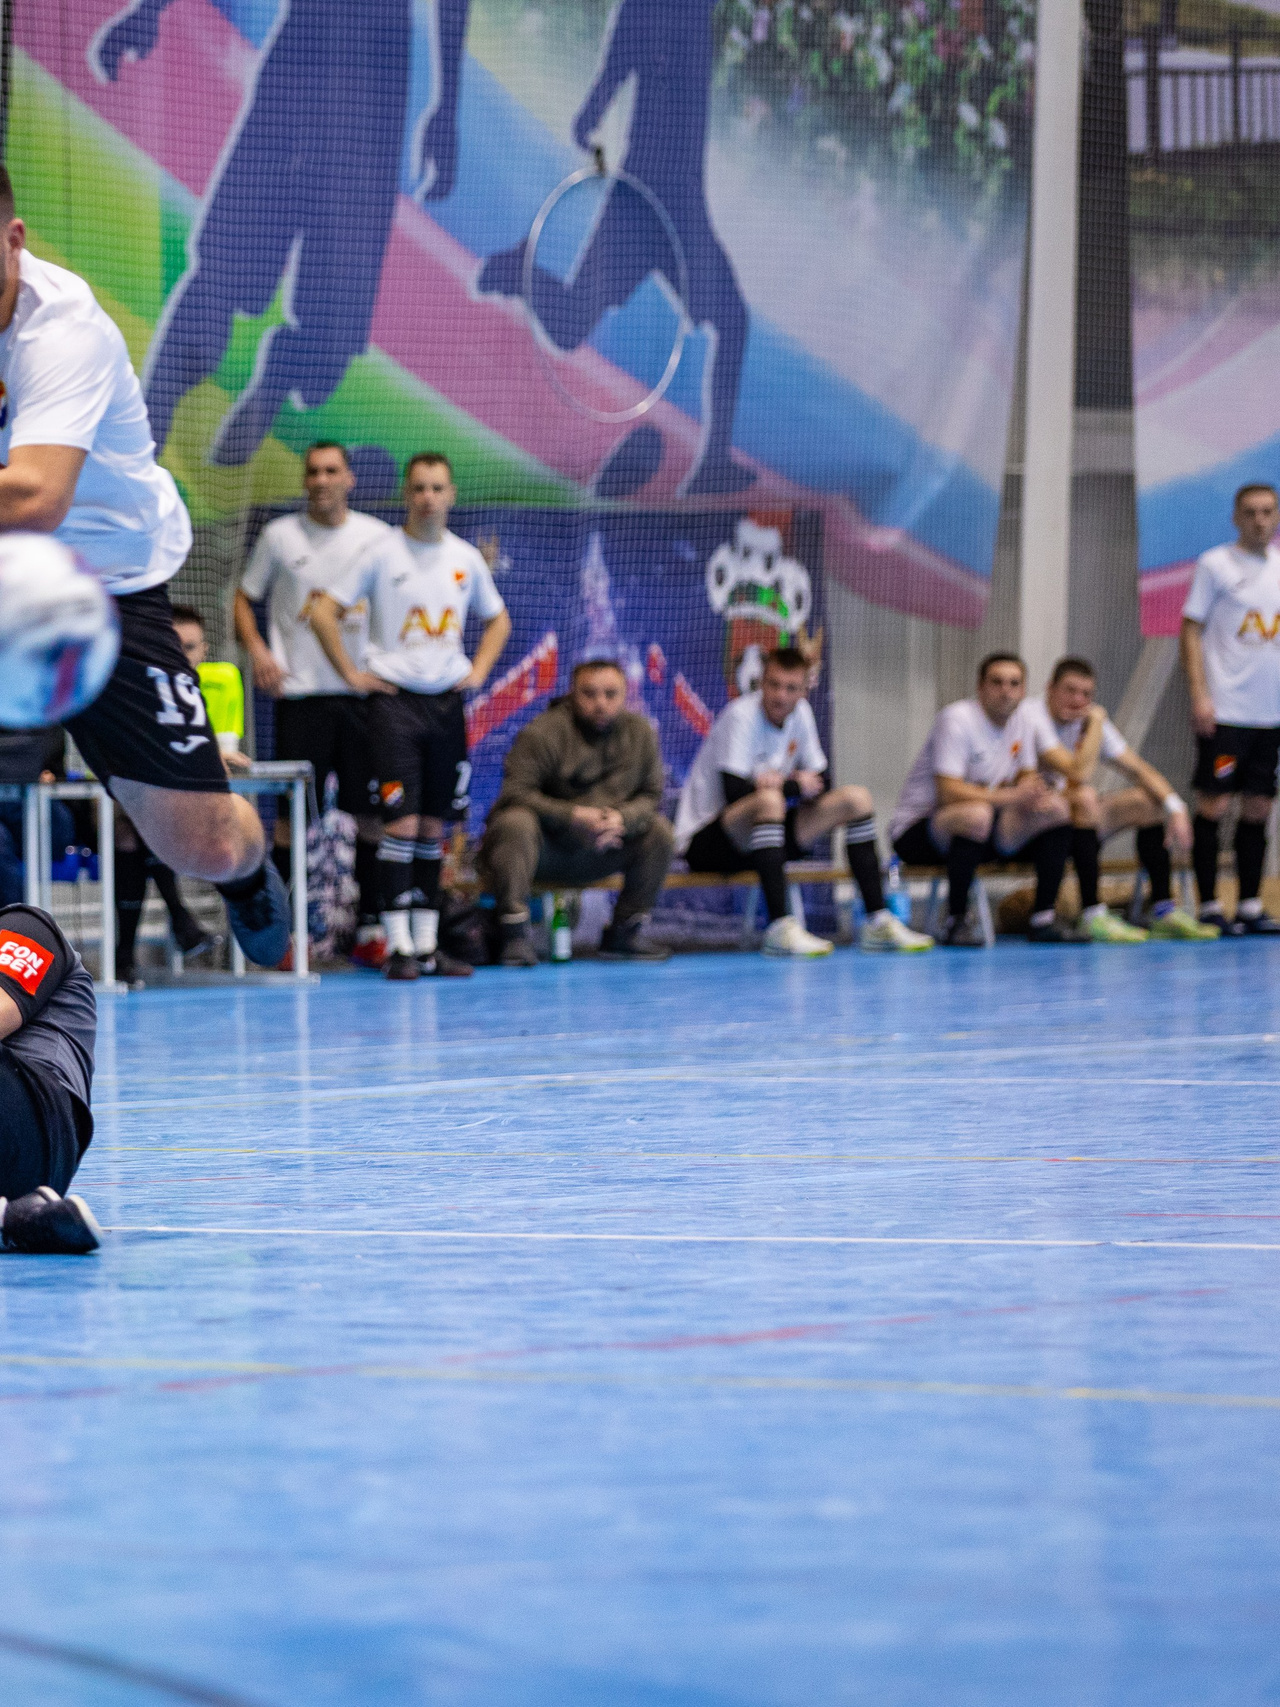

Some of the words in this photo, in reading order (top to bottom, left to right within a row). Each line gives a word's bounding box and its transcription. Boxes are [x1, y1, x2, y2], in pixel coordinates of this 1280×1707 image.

[1236, 608, 1280, 641] AV
[147, 666, 206, 726] 19
[0, 941, 44, 969] FON
